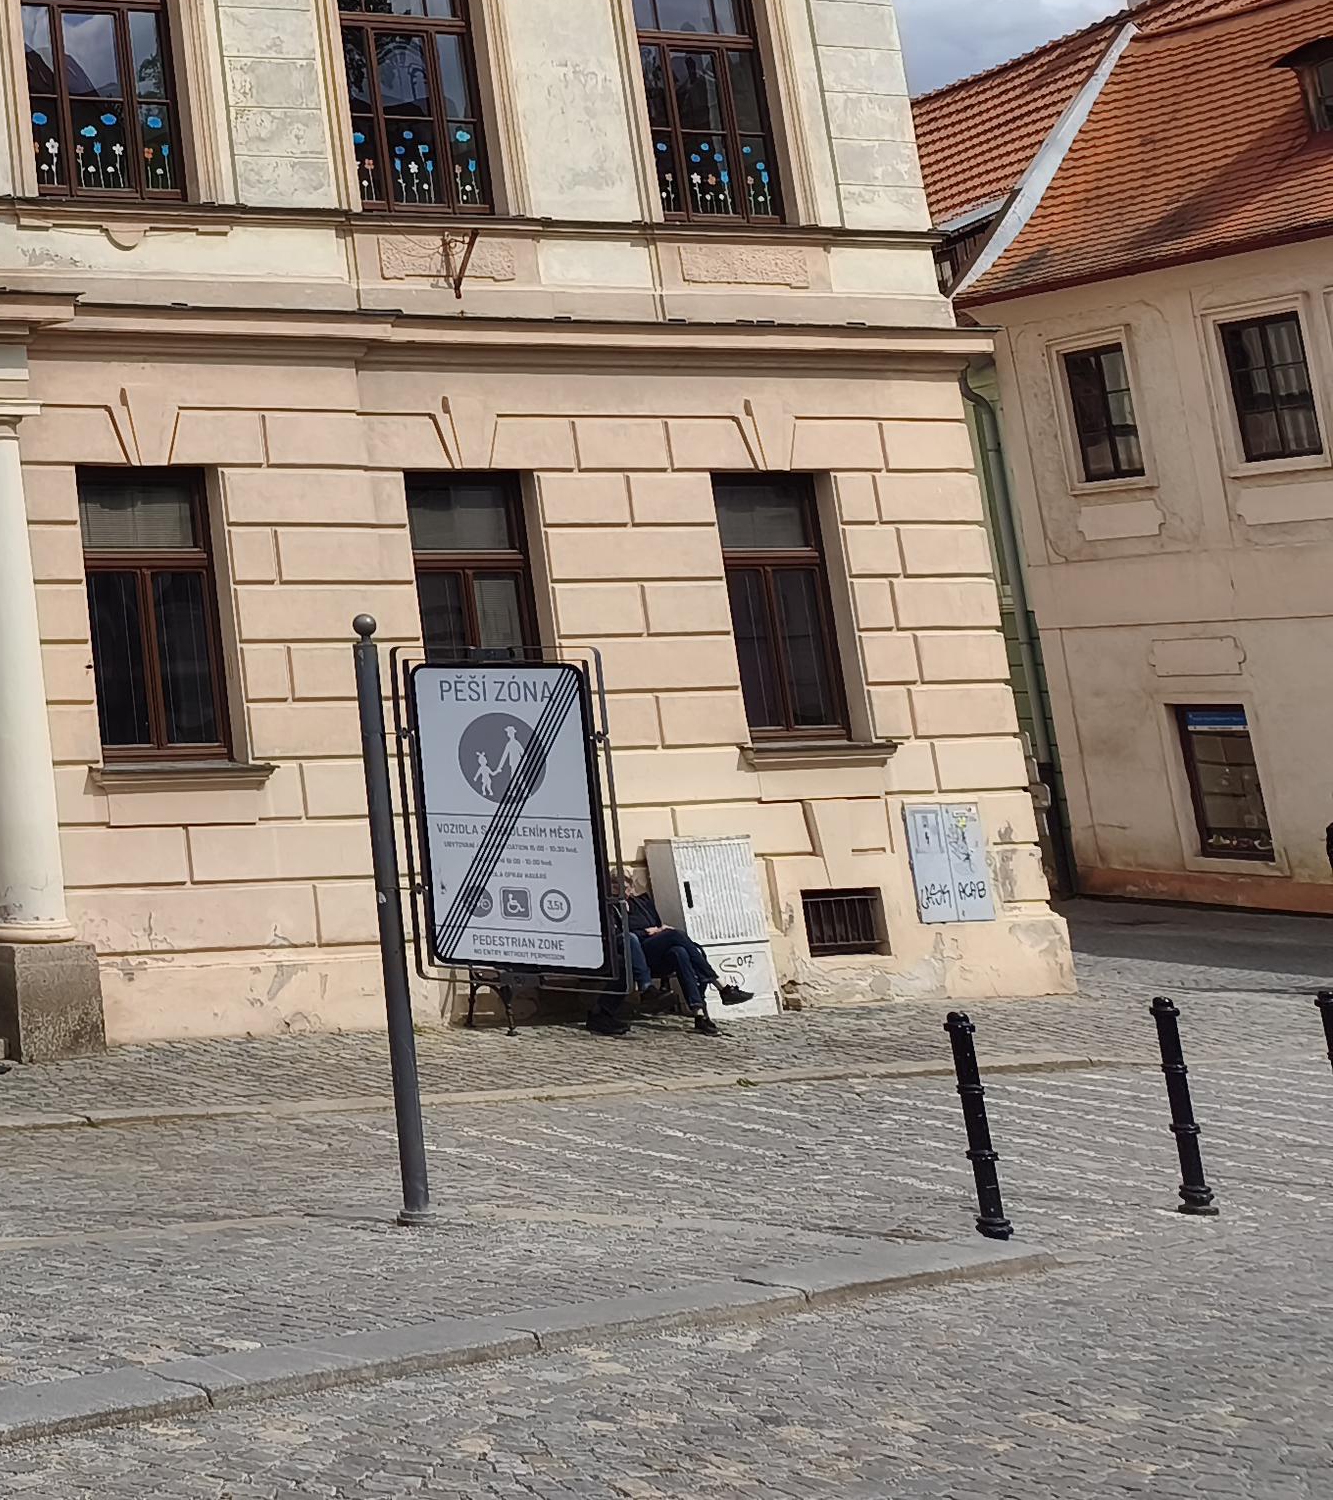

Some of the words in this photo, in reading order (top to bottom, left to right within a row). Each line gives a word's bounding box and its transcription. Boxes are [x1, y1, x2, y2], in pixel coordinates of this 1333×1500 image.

[439, 675, 487, 702] PĚŠÍ
[493, 675, 554, 703] ZÓNA
[436, 823, 478, 835] VOZIDLA
[549, 825, 584, 840] MĚSTA
[957, 880, 987, 901] ACAB
[472, 933, 536, 949] PEDESTRIAN
[537, 938, 565, 951] ZONE
